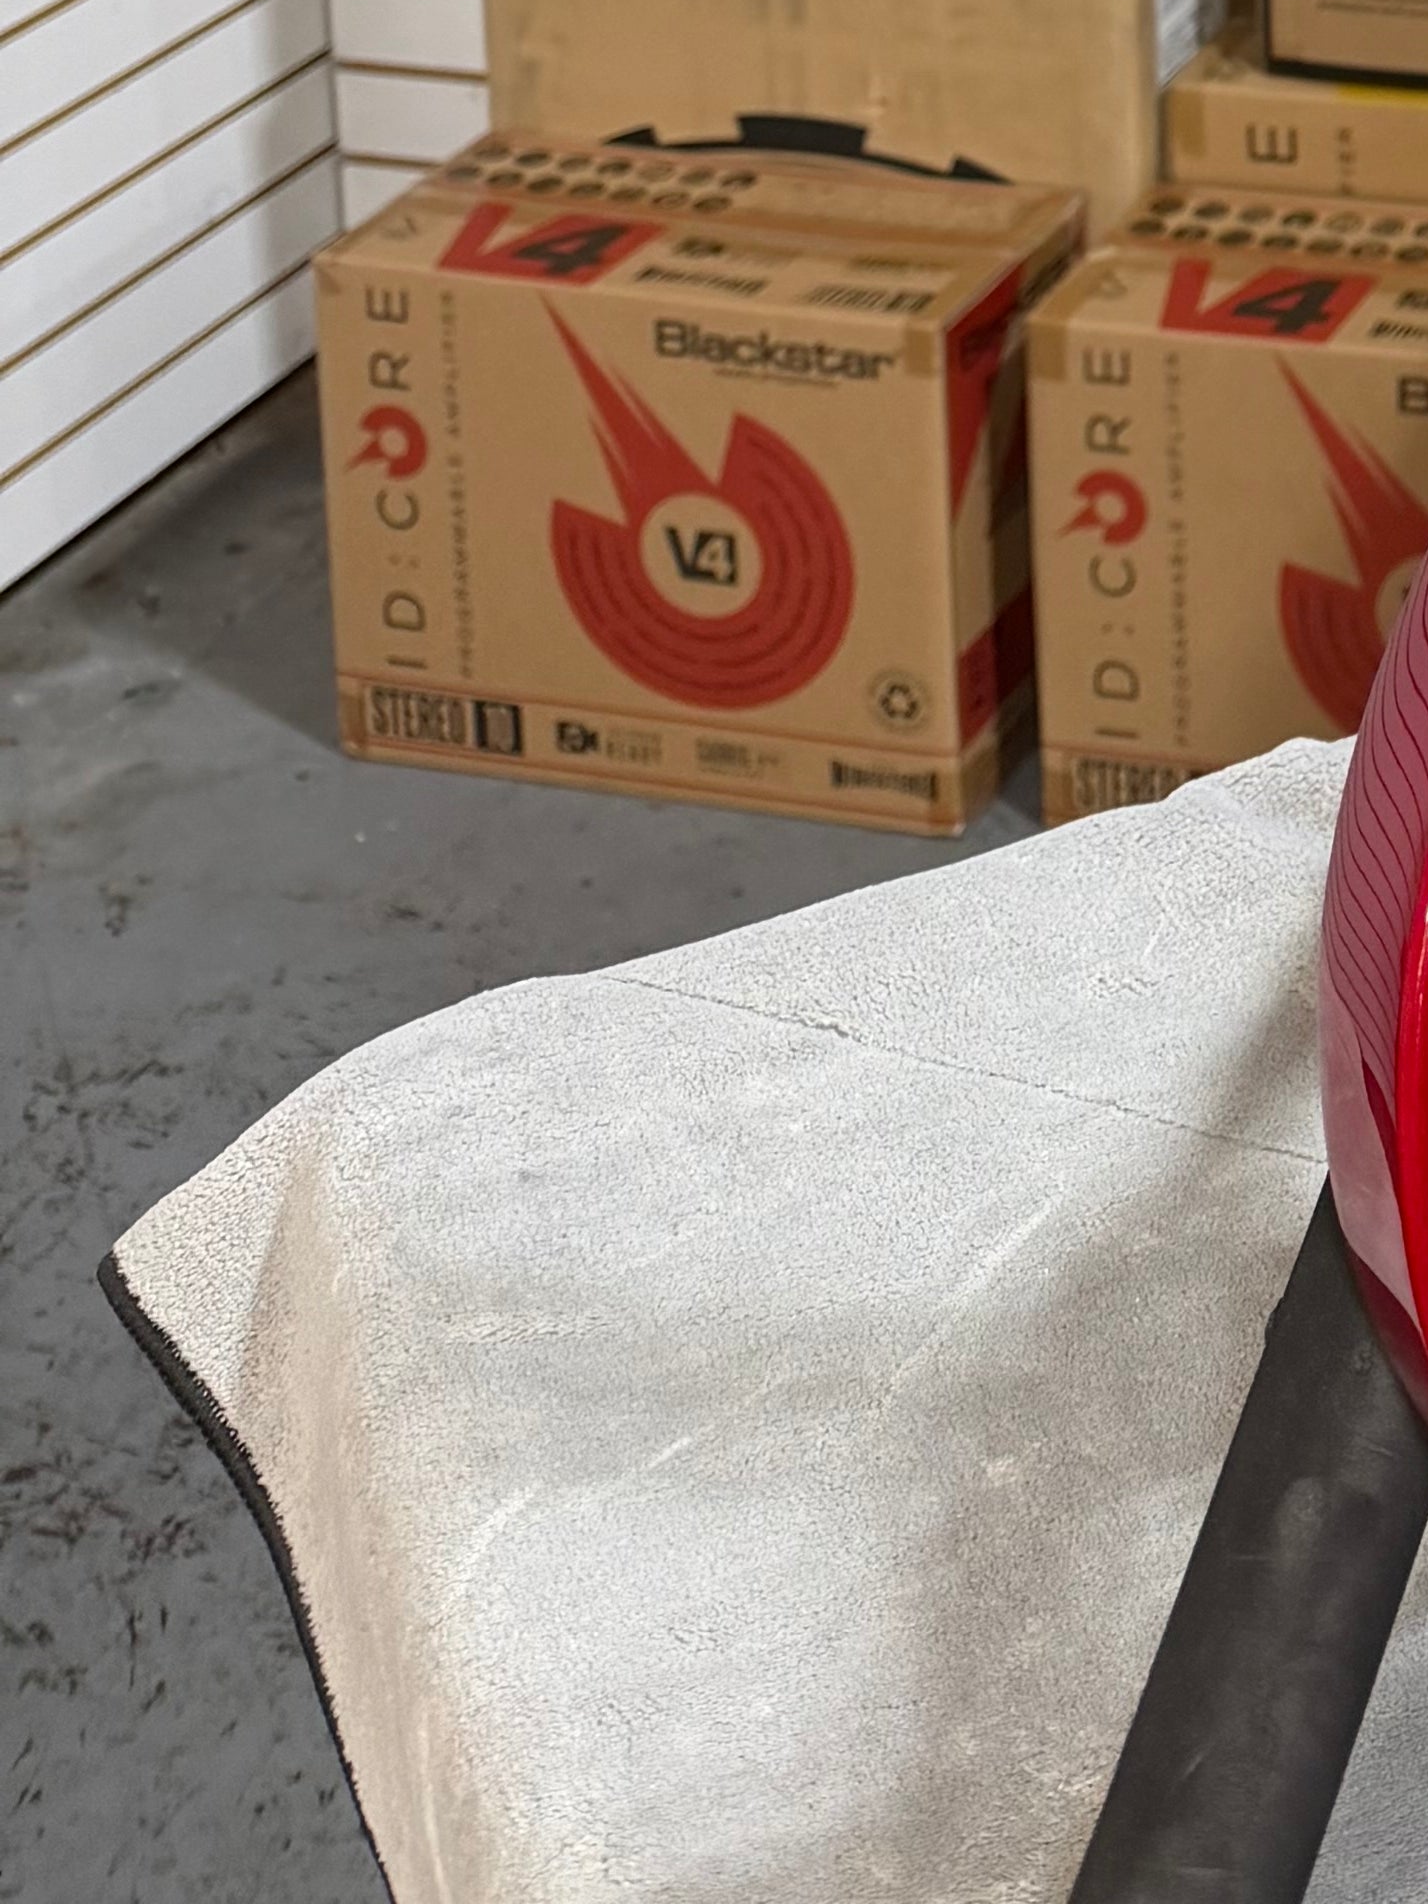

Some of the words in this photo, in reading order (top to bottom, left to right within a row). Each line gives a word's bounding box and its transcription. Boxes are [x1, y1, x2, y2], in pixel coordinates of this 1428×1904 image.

[653, 317, 897, 381] Blackstar
[663, 525, 740, 587] V4
[370, 687, 468, 747] STEREO
